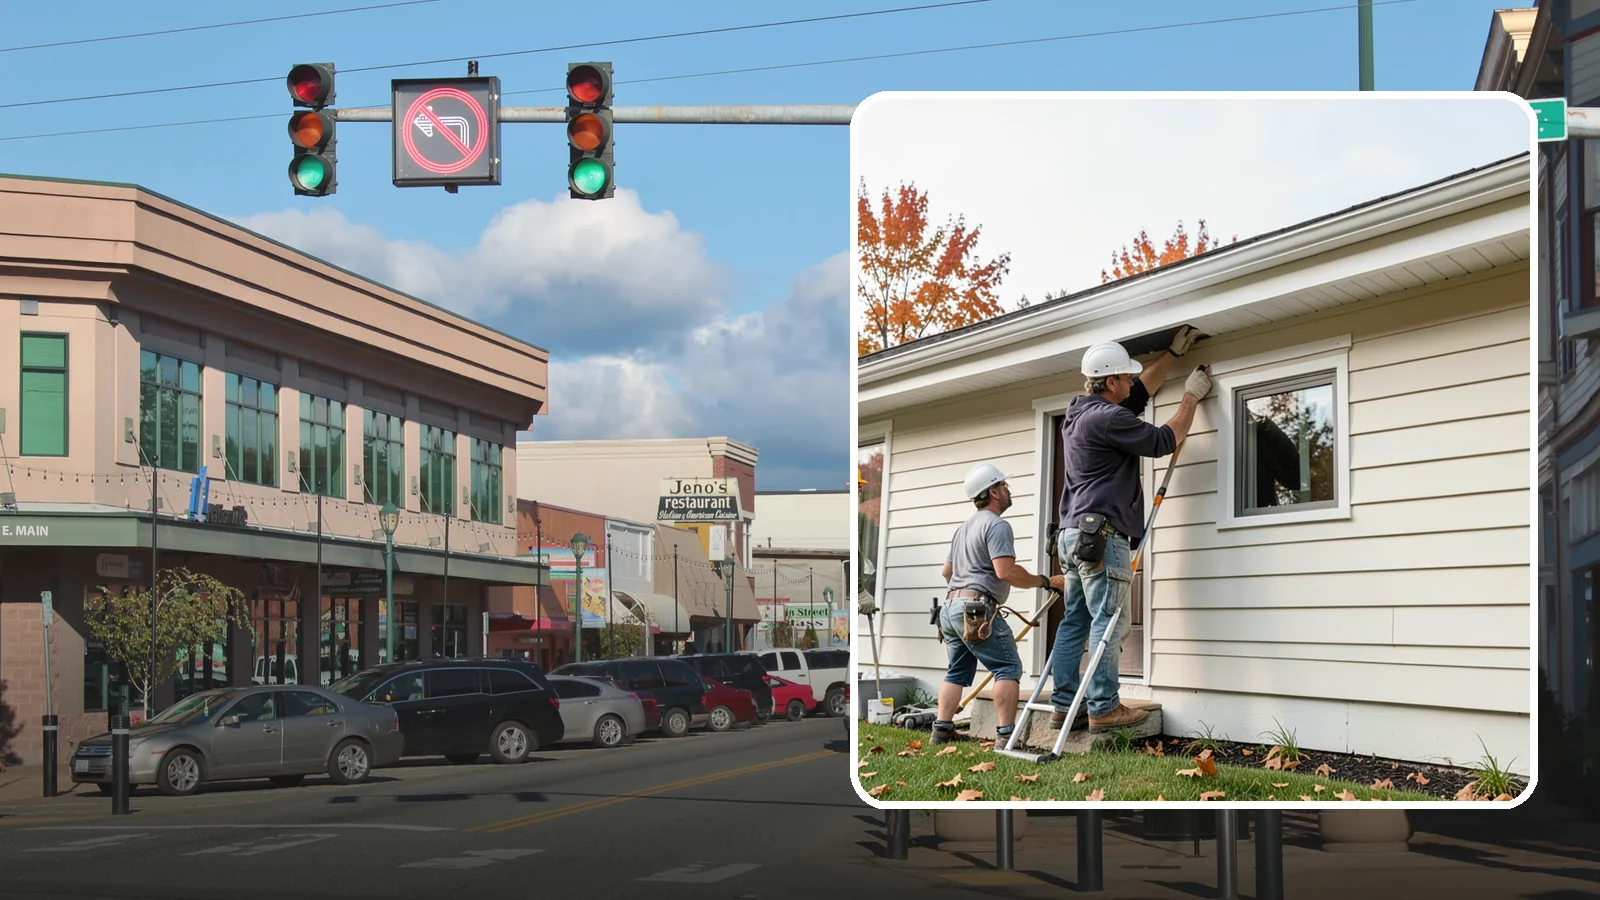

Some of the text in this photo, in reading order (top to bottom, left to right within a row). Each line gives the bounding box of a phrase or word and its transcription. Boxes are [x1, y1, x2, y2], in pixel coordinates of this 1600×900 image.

[670, 480, 727, 494] Jeno's
[665, 496, 731, 509] restaurant
[659, 510, 682, 519] Italian
[686, 510, 714, 519] American
[715, 510, 737, 519] Cuisine
[2, 525, 49, 536] E. MAIN
[797, 608, 828, 617] Street
